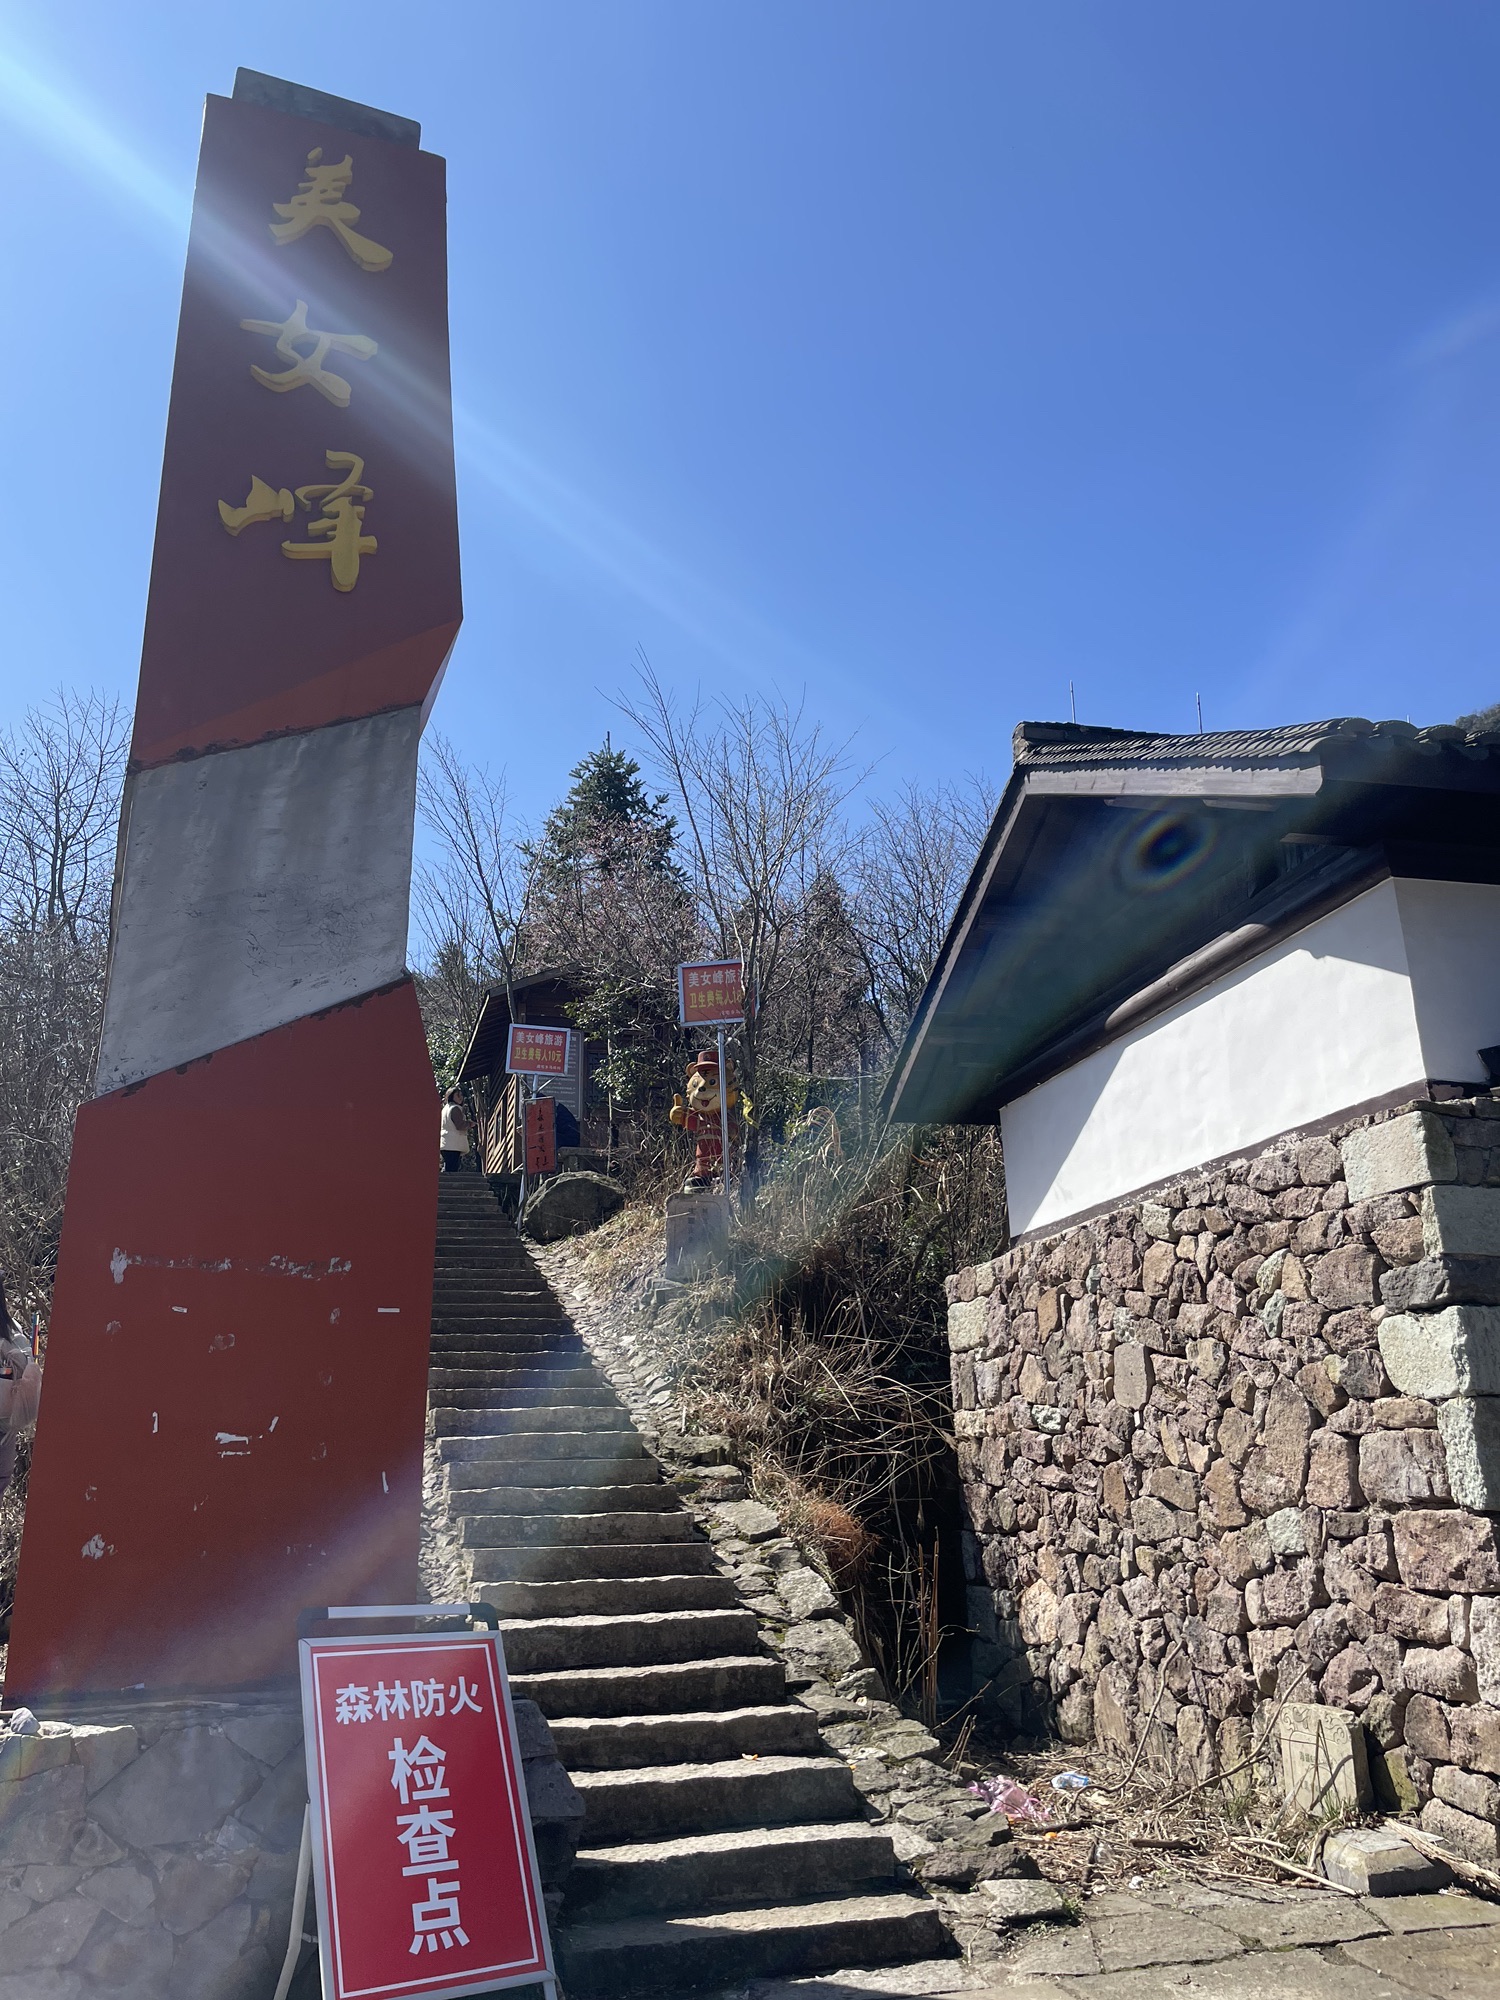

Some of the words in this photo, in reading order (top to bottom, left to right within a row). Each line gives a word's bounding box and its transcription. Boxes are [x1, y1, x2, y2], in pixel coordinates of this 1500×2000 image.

[218, 147, 394, 593] 美女峰
[513, 1046, 562, 1063] 卫生费每人10元
[515, 1031, 564, 1047] 美女峰旅游
[335, 1675, 484, 1725] 森林防火
[388, 1734, 471, 1956] 检查点
